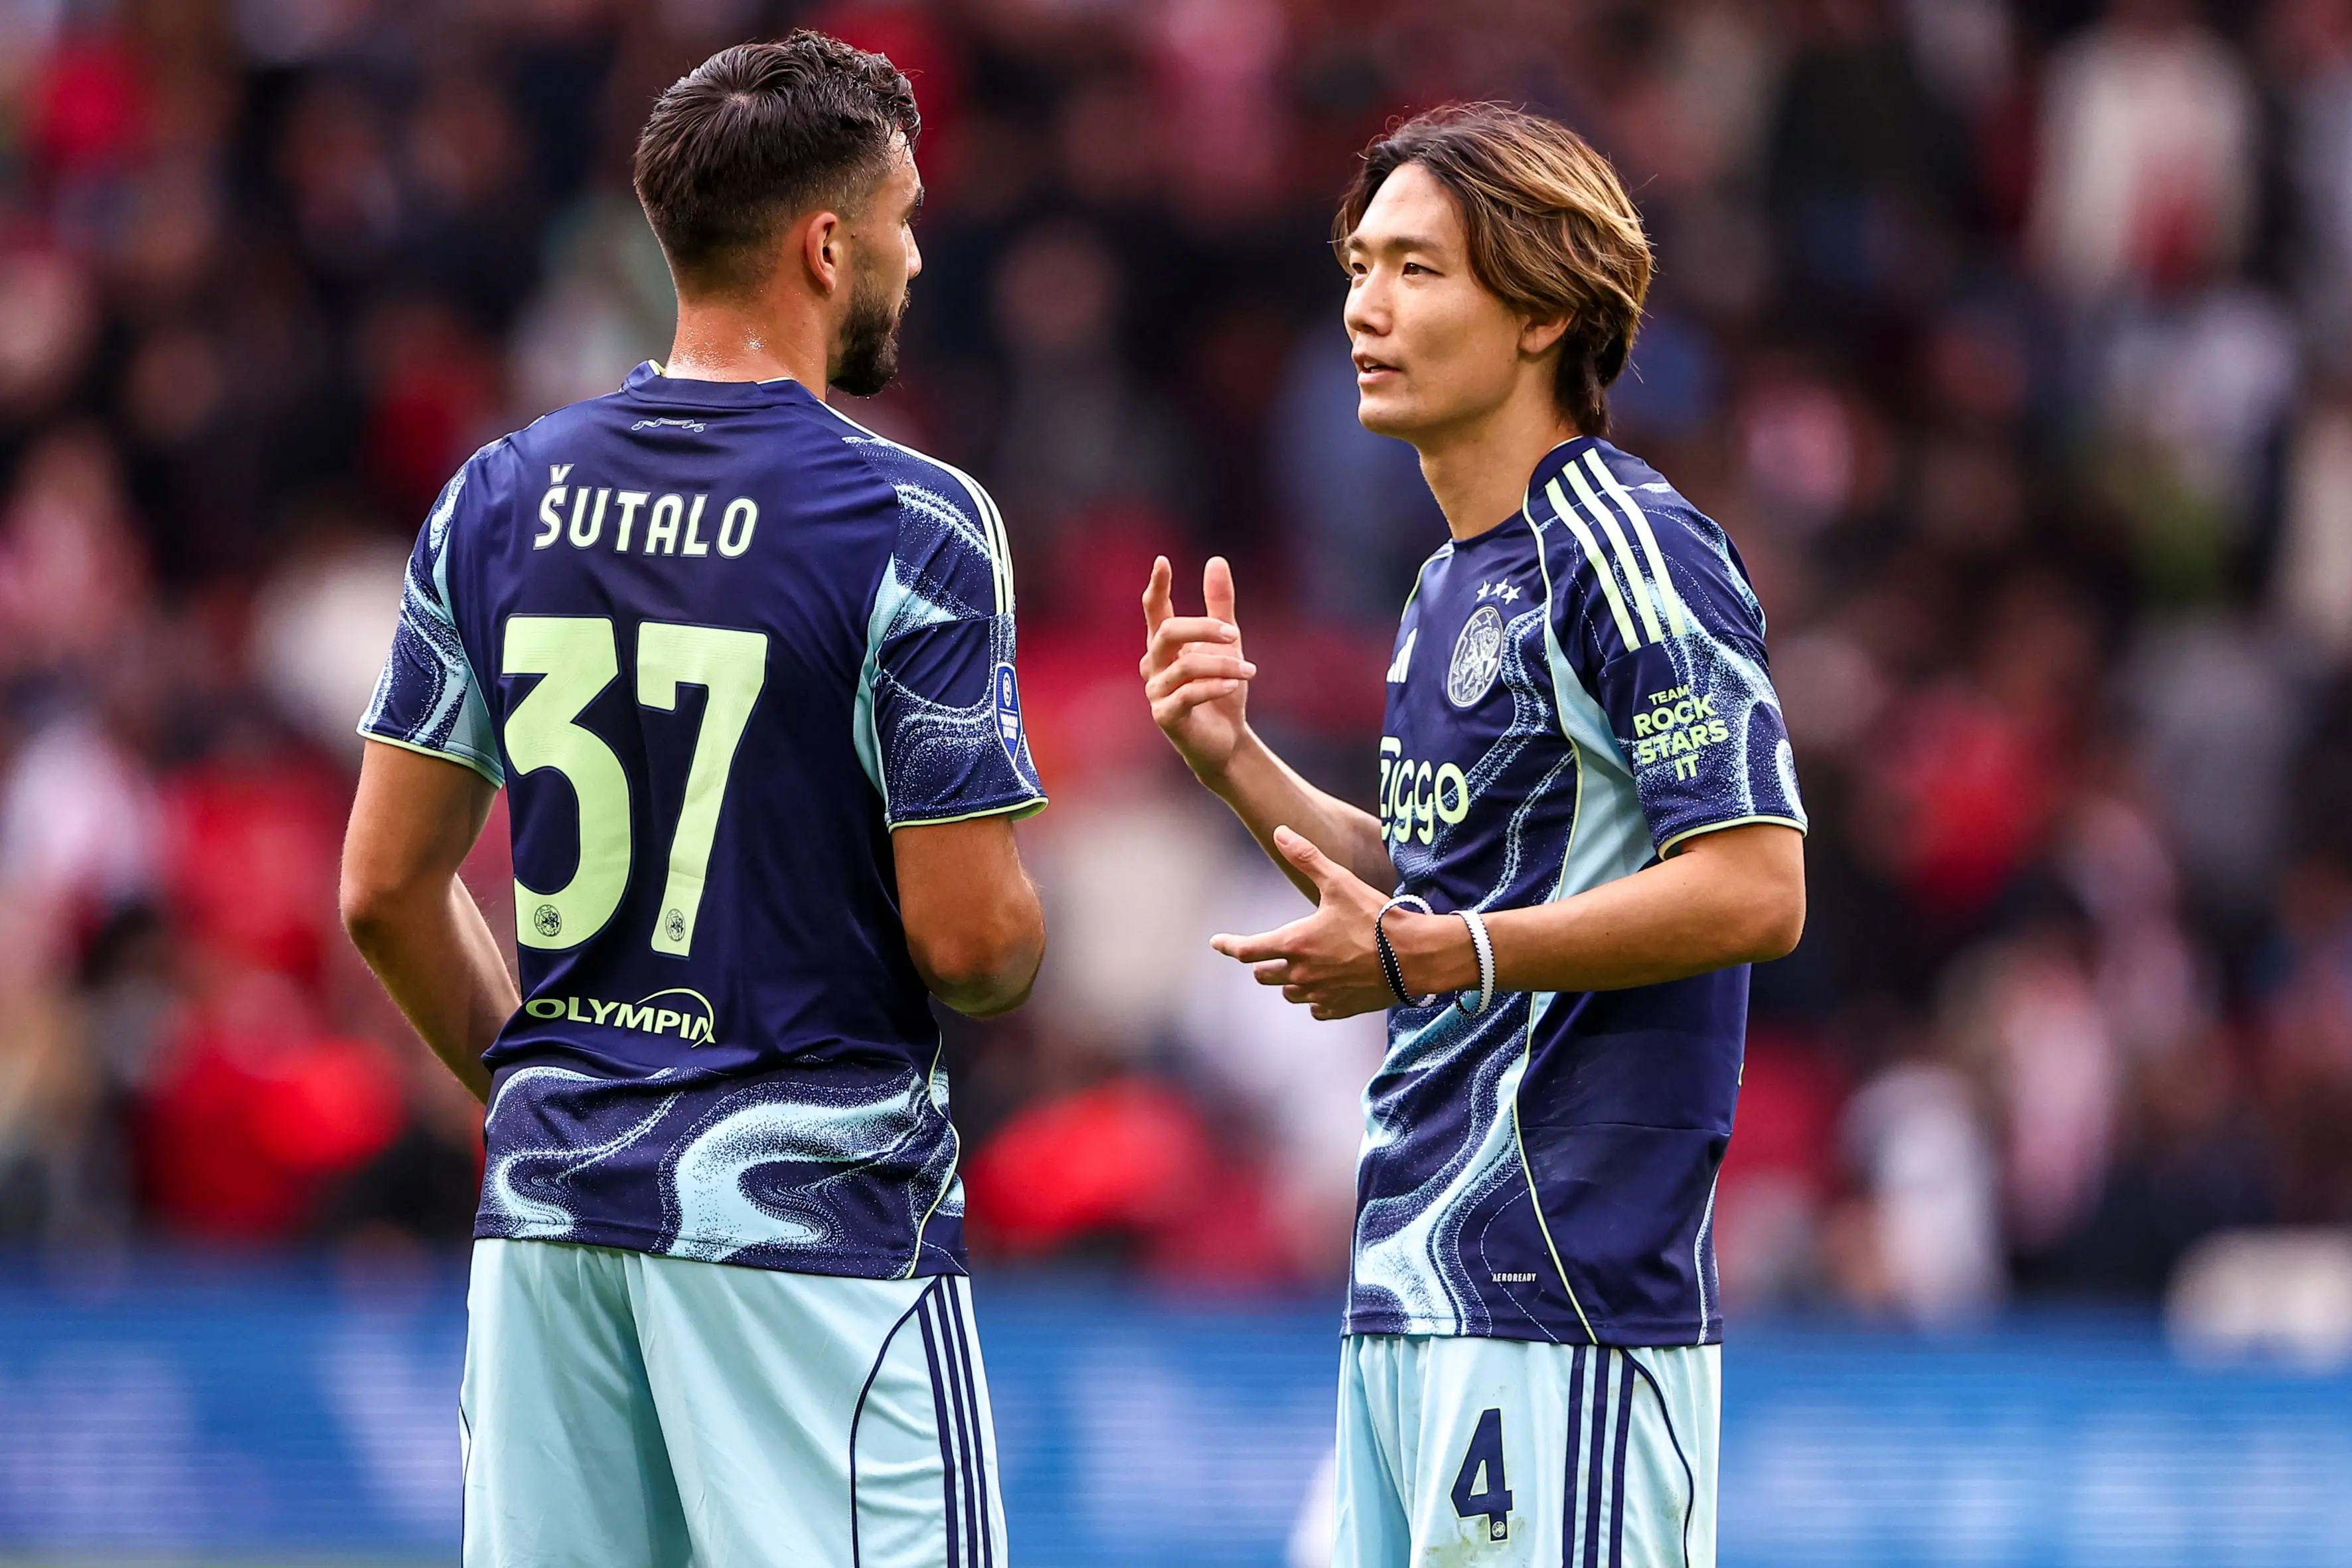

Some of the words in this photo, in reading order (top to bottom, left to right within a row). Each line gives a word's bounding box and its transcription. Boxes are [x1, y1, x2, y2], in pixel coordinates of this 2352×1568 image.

[534, 463, 759, 559] ŠUTALO
[1633, 694, 1717, 738] ROCK
[1648, 684, 1690, 705] TEAM
[1638, 720, 1729, 764] STARS
[502, 615, 768, 957] 37
[1673, 754, 1700, 782] IT
[526, 994, 716, 1045] OLYMPIA
[1492, 1273, 1537, 1282] AEROREADY
[1450, 1408, 1512, 1541] 4
